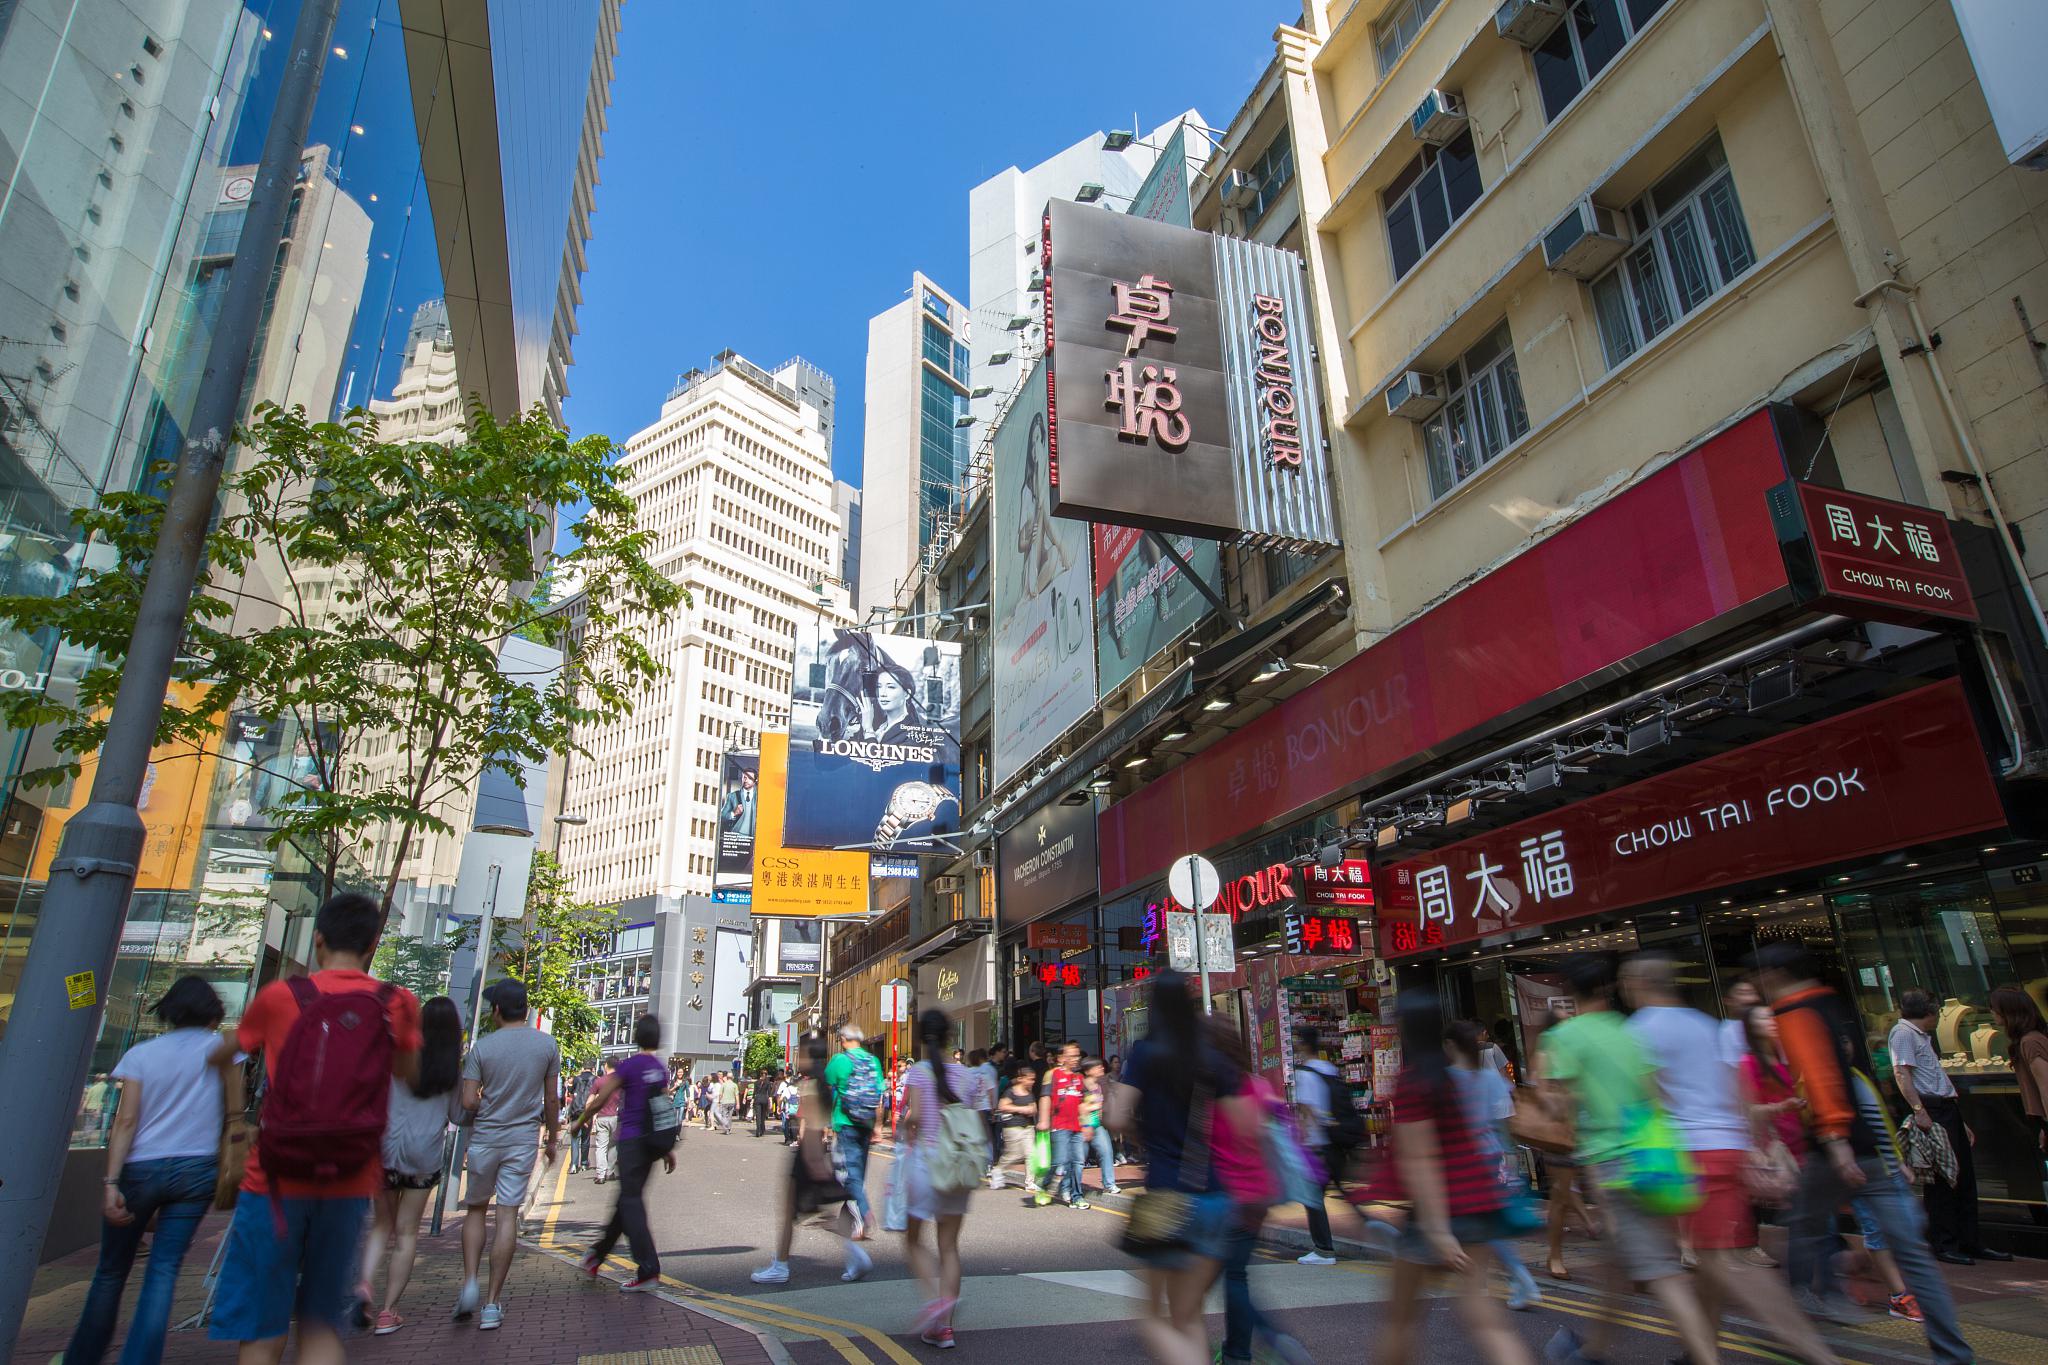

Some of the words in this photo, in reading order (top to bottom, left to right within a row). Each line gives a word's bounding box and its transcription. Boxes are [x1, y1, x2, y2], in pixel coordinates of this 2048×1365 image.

[1254, 293, 1302, 467] BONJOUR
[1825, 503, 1940, 563] 周大福
[1842, 569, 1884, 589] CHOW
[1886, 577, 1911, 593] TAI
[1915, 582, 1954, 601] FOOK
[900, 723, 921, 732] Elegance
[1285, 673, 1415, 771] BONJOUR
[820, 738, 934, 763] LONGINES
[1615, 818, 1692, 857] CHOW
[1700, 798, 1751, 834] TAI
[1767, 767, 1866, 817] FOOK
[761, 856, 800, 870] CSS
[1013, 854, 1040, 882] VACHERON
[1040, 833, 1074, 867] CONSTANTIN
[1314, 865, 1363, 883] 周大福
[1415, 829, 1575, 932] 周大福
[1348, 892, 1366, 900] FOOK
[1262, 1055, 1280, 1070] Sale
